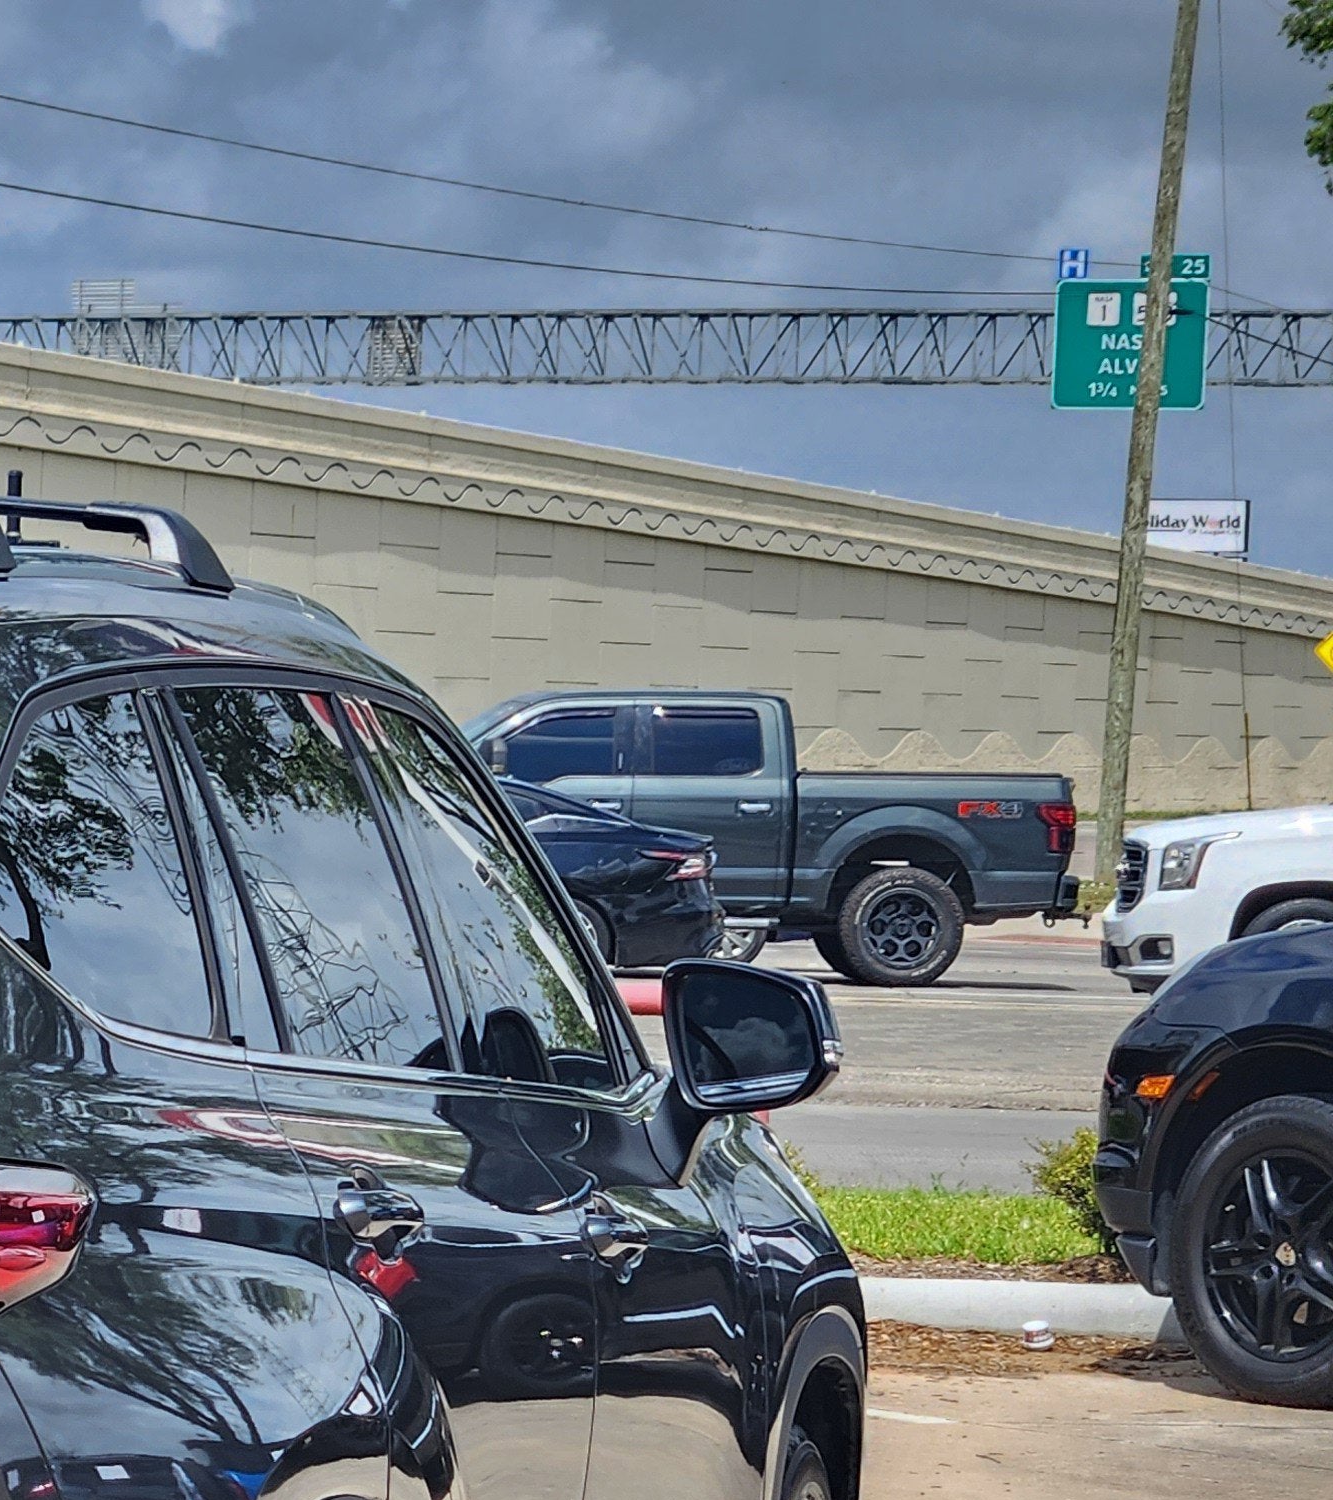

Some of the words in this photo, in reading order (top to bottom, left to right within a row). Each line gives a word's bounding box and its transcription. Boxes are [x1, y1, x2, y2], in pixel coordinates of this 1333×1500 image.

[1181, 258, 1206, 274] 25
[1101, 333, 1144, 351] NAS
[1098, 358, 1139, 375] ALV
[957, 801, 1023, 818] FX4
